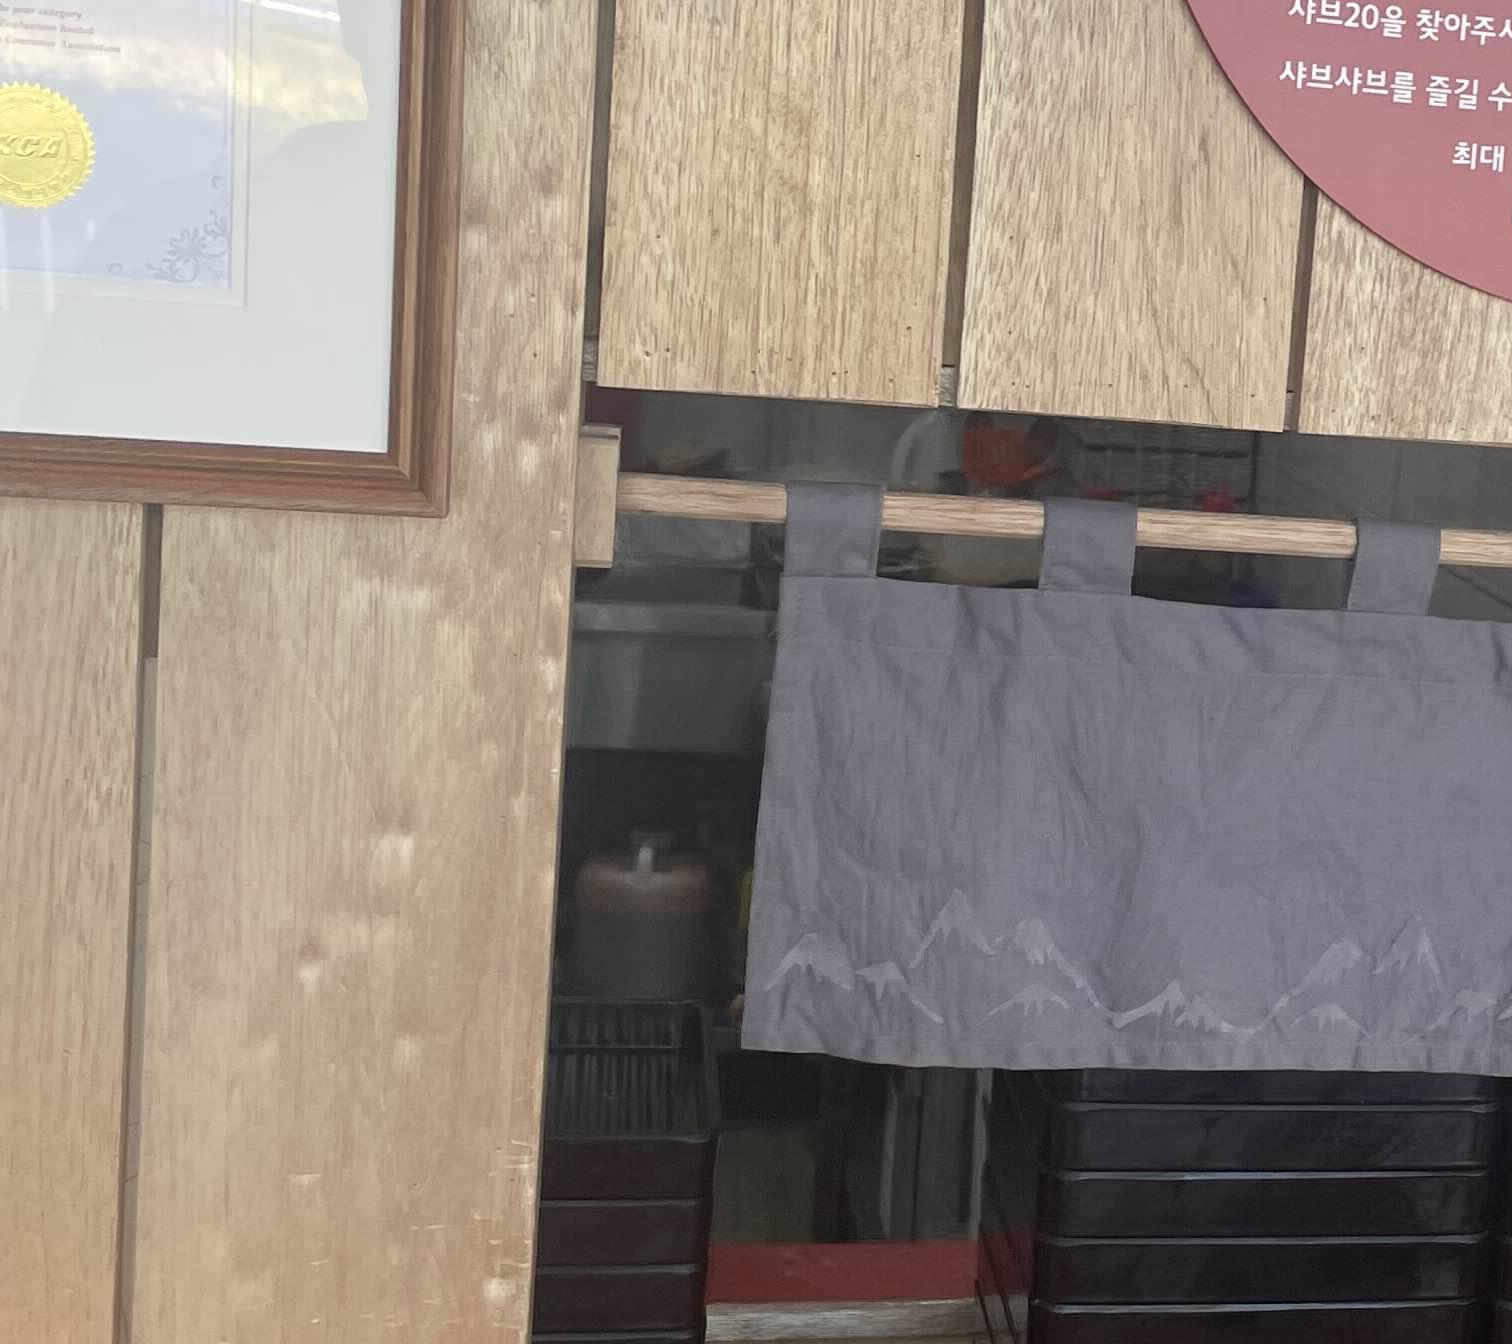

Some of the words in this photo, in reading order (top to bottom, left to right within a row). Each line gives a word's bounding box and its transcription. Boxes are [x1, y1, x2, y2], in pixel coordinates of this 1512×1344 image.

[1279, 61, 1414, 105] 샤브샤브를
[1425, 76, 1479, 111] 즐길
[1452, 140, 1505, 174] 최대
